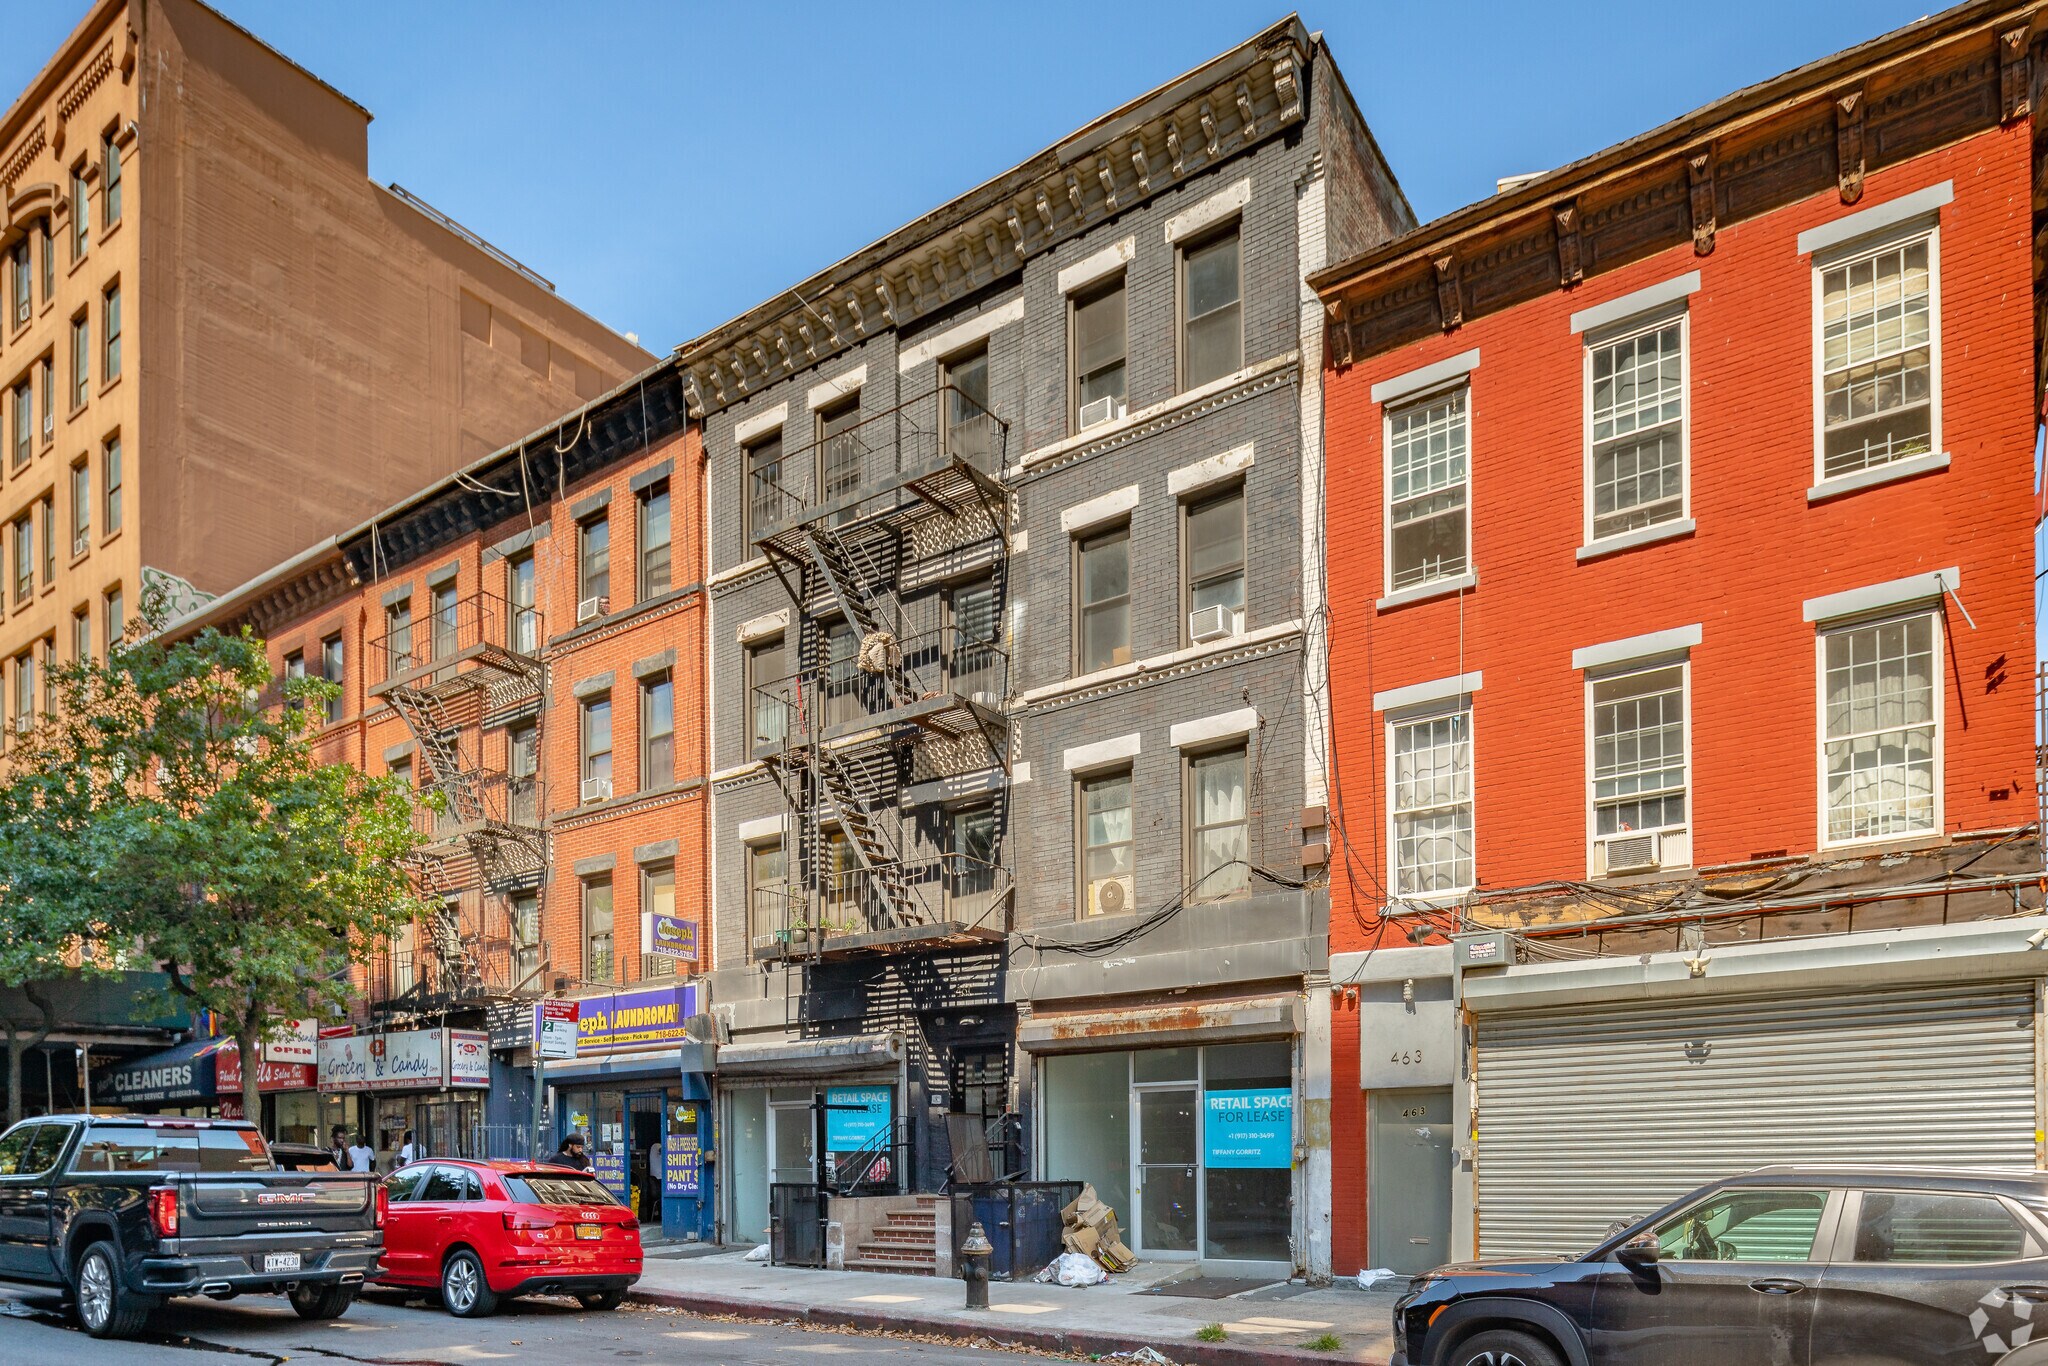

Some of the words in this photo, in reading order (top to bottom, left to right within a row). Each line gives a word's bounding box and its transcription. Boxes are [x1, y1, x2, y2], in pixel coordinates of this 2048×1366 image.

[659, 922, 693, 941] Joseph
[655, 939, 694, 952] LAUNDROMAT
[611, 1003, 680, 1029] LAUNDROMAT
[545, 1022, 551, 1031] 2
[430, 1032, 440, 1041] 459
[273, 1046, 312, 1055] OPEN
[1391, 1050, 1422, 1065] 463
[328, 1058, 365, 1080] Grocery
[375, 1058, 384, 1077] &
[391, 1053, 429, 1076] Candy
[114, 1065, 192, 1092] CLEANERS
[273, 1068, 291, 1081] Salon
[144, 1092, 165, 1101] SERVICE
[832, 1093, 859, 1104] RETAIL
[861, 1092, 888, 1103] SPACE
[1210, 1097, 1251, 1110] RETAIL
[1254, 1096, 1292, 1109] SPACE
[1218, 1111, 1244, 1123] FOR
[1247, 1110, 1285, 1123] LEASE
[1402, 1106, 1425, 1118] 463
[1234, 1132, 1248, 1140] (917)
[667, 1153, 692, 1166] SHIRT
[667, 1169, 692, 1182] PANT
[667, 1183, 677, 1191] (No
[677, 1183, 687, 1191] Dry
[257, 1193, 316, 1205] GMC
